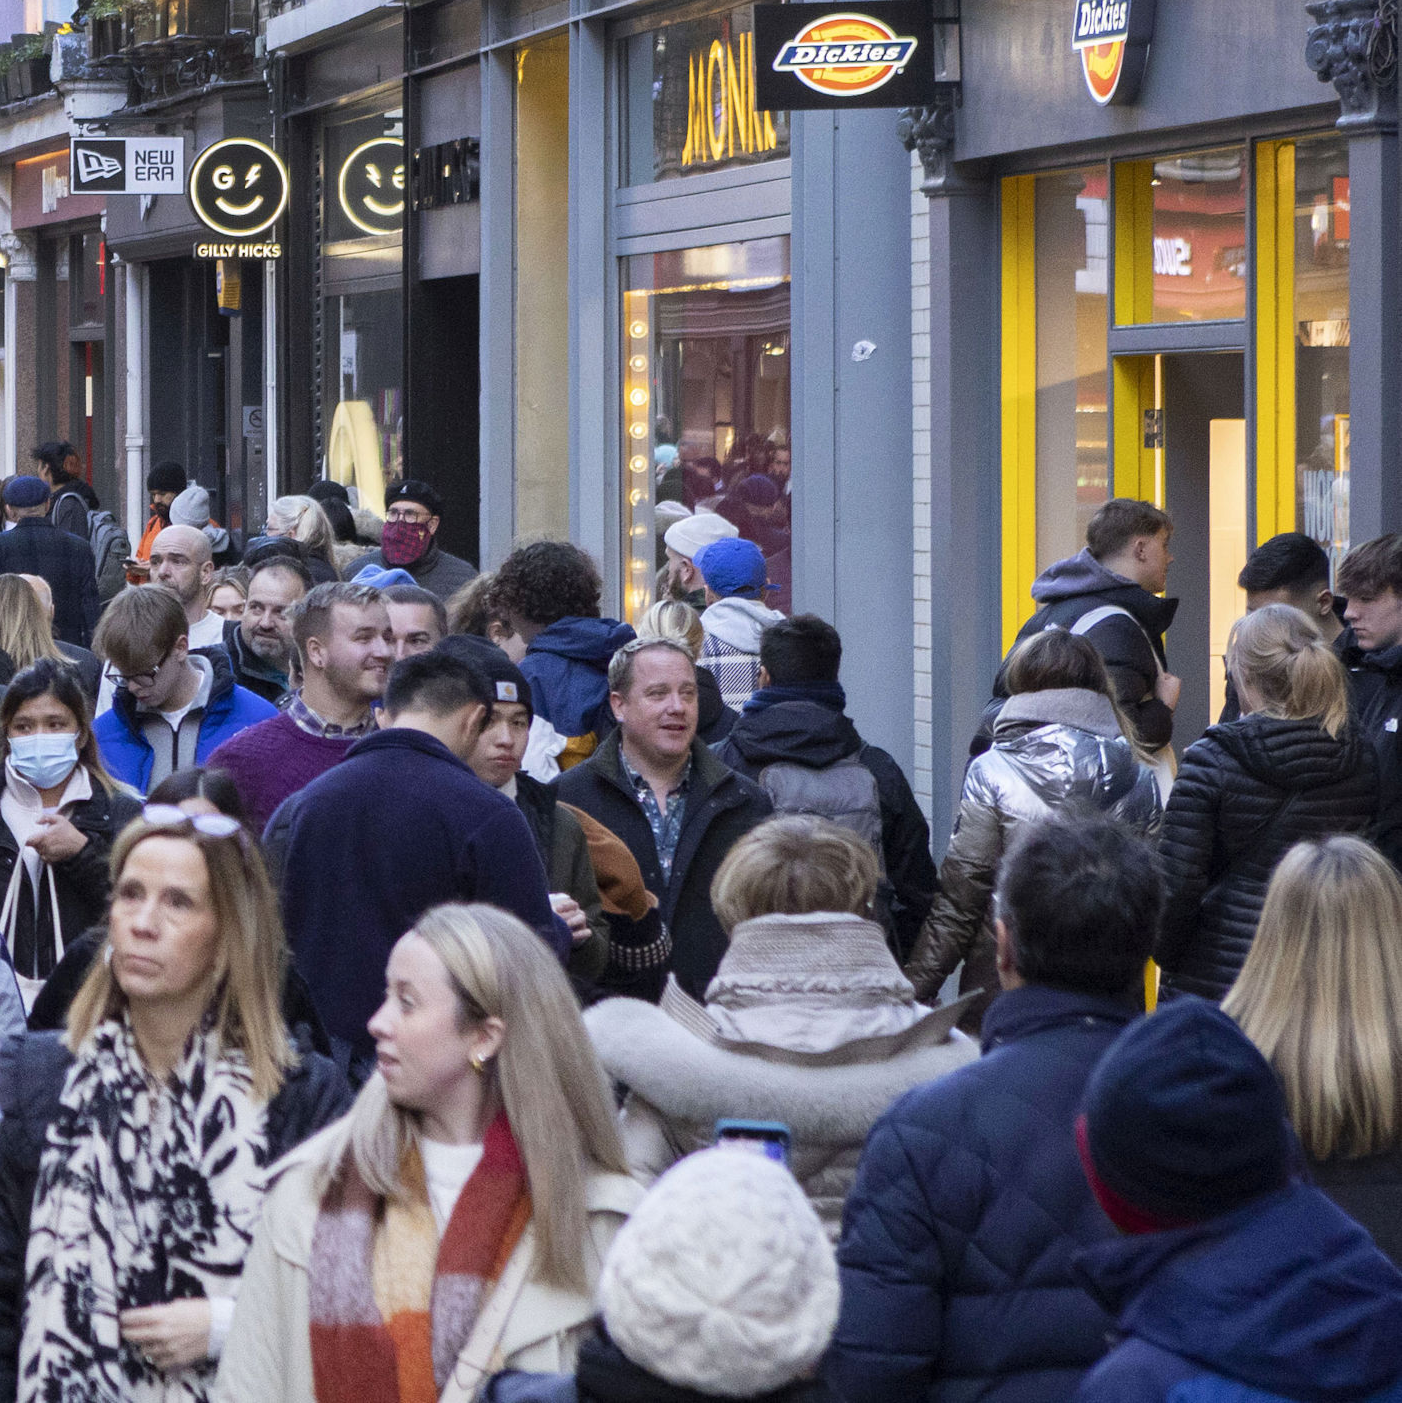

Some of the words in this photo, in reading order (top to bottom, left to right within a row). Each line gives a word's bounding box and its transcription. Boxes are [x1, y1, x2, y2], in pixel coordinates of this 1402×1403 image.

[789, 44, 903, 64] Dickies
[135, 150, 174, 165] NEW
[135, 166, 174, 182] ERA
[197, 244, 235, 259] GILLY
[238, 243, 282, 259] HICKS
